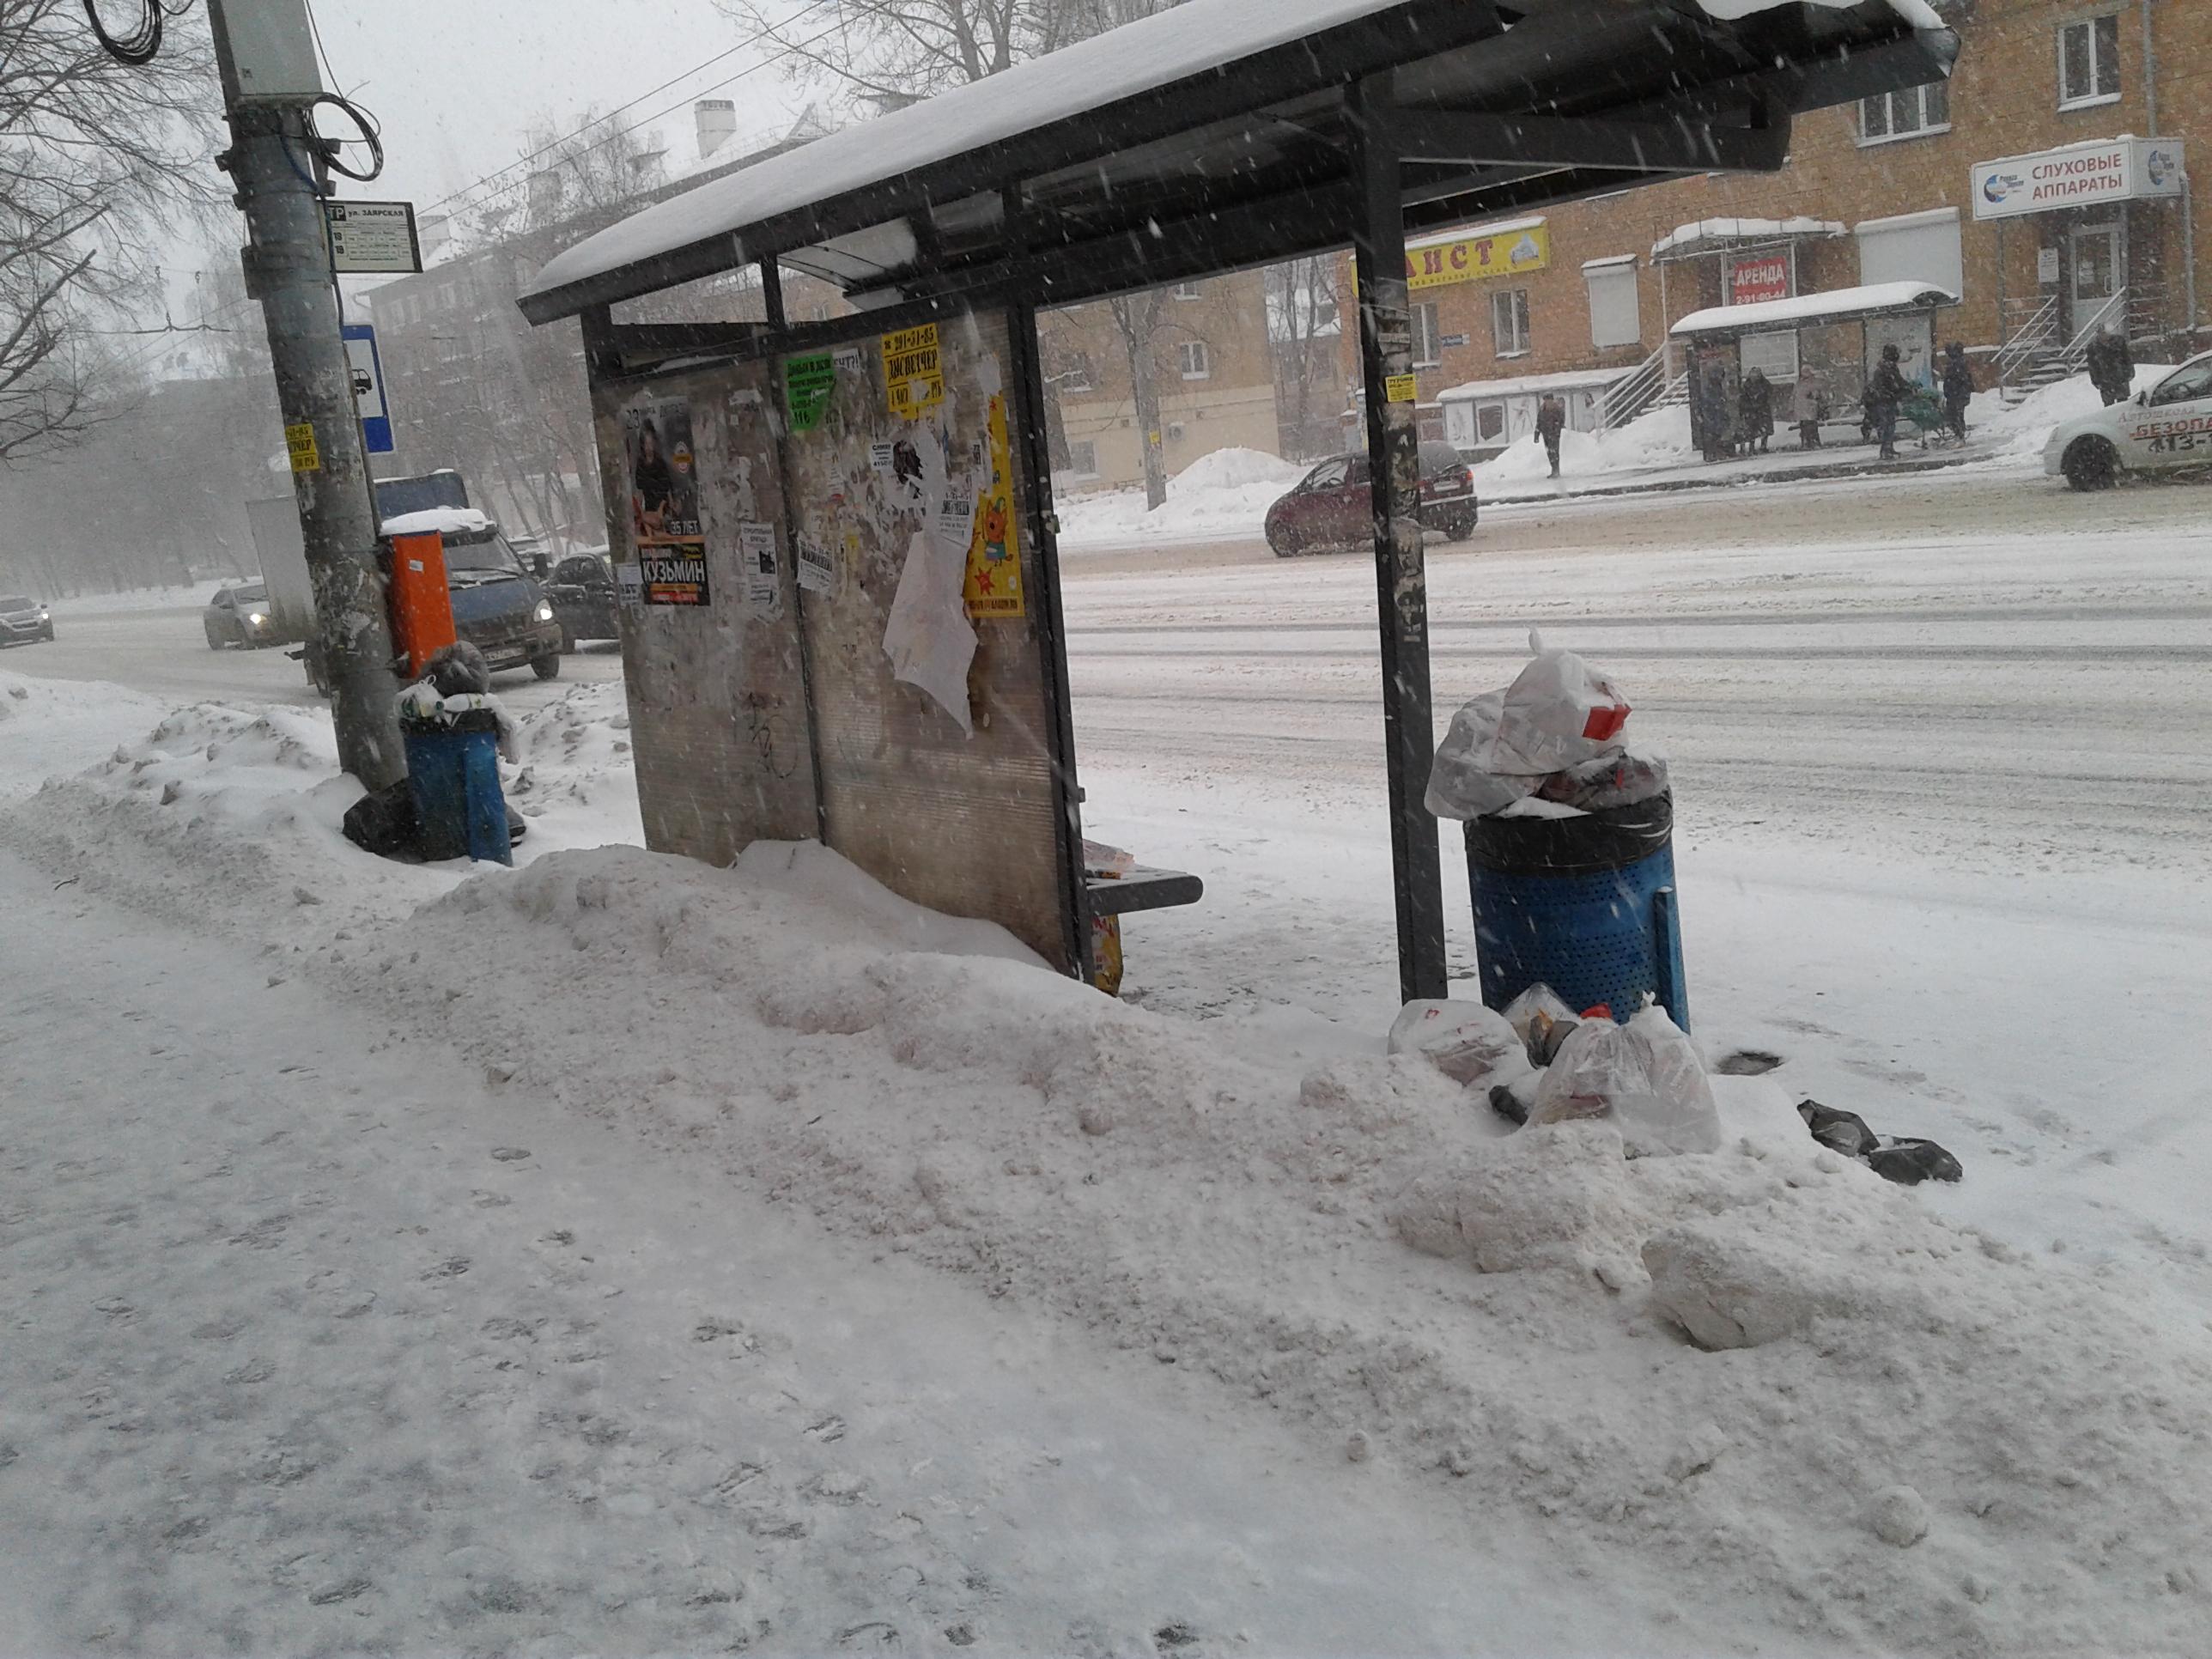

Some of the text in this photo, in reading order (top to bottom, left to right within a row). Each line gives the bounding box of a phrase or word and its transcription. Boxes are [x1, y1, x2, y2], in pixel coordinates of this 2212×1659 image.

[2032, 153, 2122, 180] СЛУХОВЫЕ
[2033, 174, 2122, 200] АППАРАТЫ
[1736, 263, 1785, 286] АРЕНДА
[671, 520, 700, 536] 35 ЛЕТ
[642, 560, 706, 583] КУЗЬМИН
